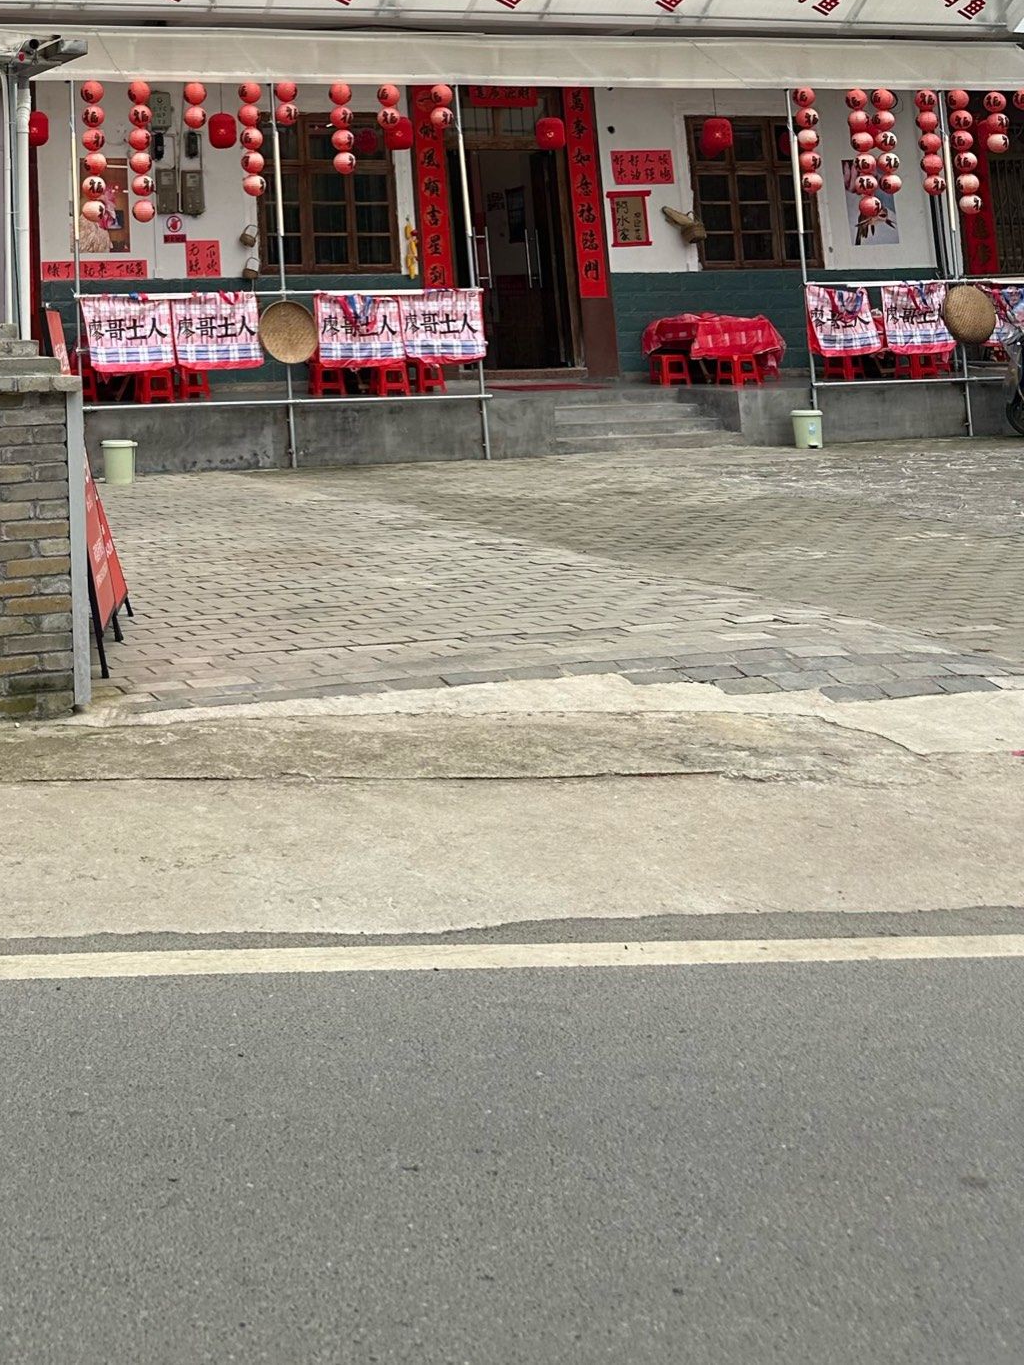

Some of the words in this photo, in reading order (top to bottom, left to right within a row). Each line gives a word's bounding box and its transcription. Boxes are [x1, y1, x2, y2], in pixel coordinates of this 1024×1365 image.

[89, 317, 168, 341] 廖哥土人
[178, 315, 256, 340] 廖哥土人
[404, 313, 479, 335] 廖哥土人
